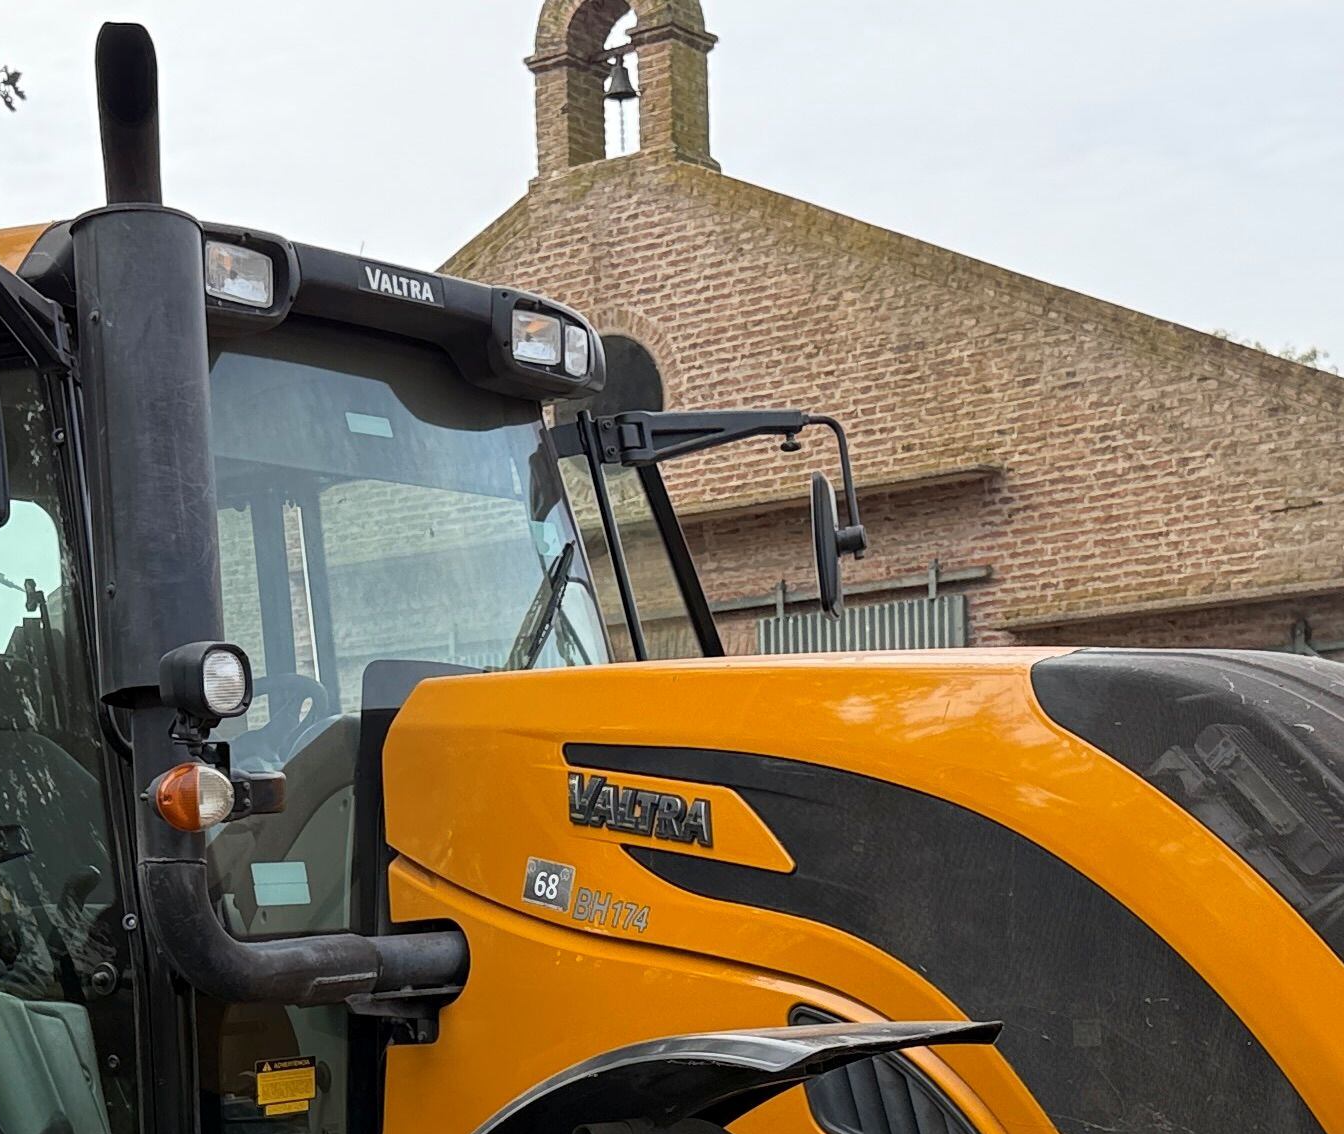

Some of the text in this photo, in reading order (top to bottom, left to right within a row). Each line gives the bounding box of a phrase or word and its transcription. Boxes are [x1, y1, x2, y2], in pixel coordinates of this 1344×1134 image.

[364, 265, 434, 303] VALTRA
[567, 771, 714, 848] VALTRA
[533, 871, 560, 900] 68
